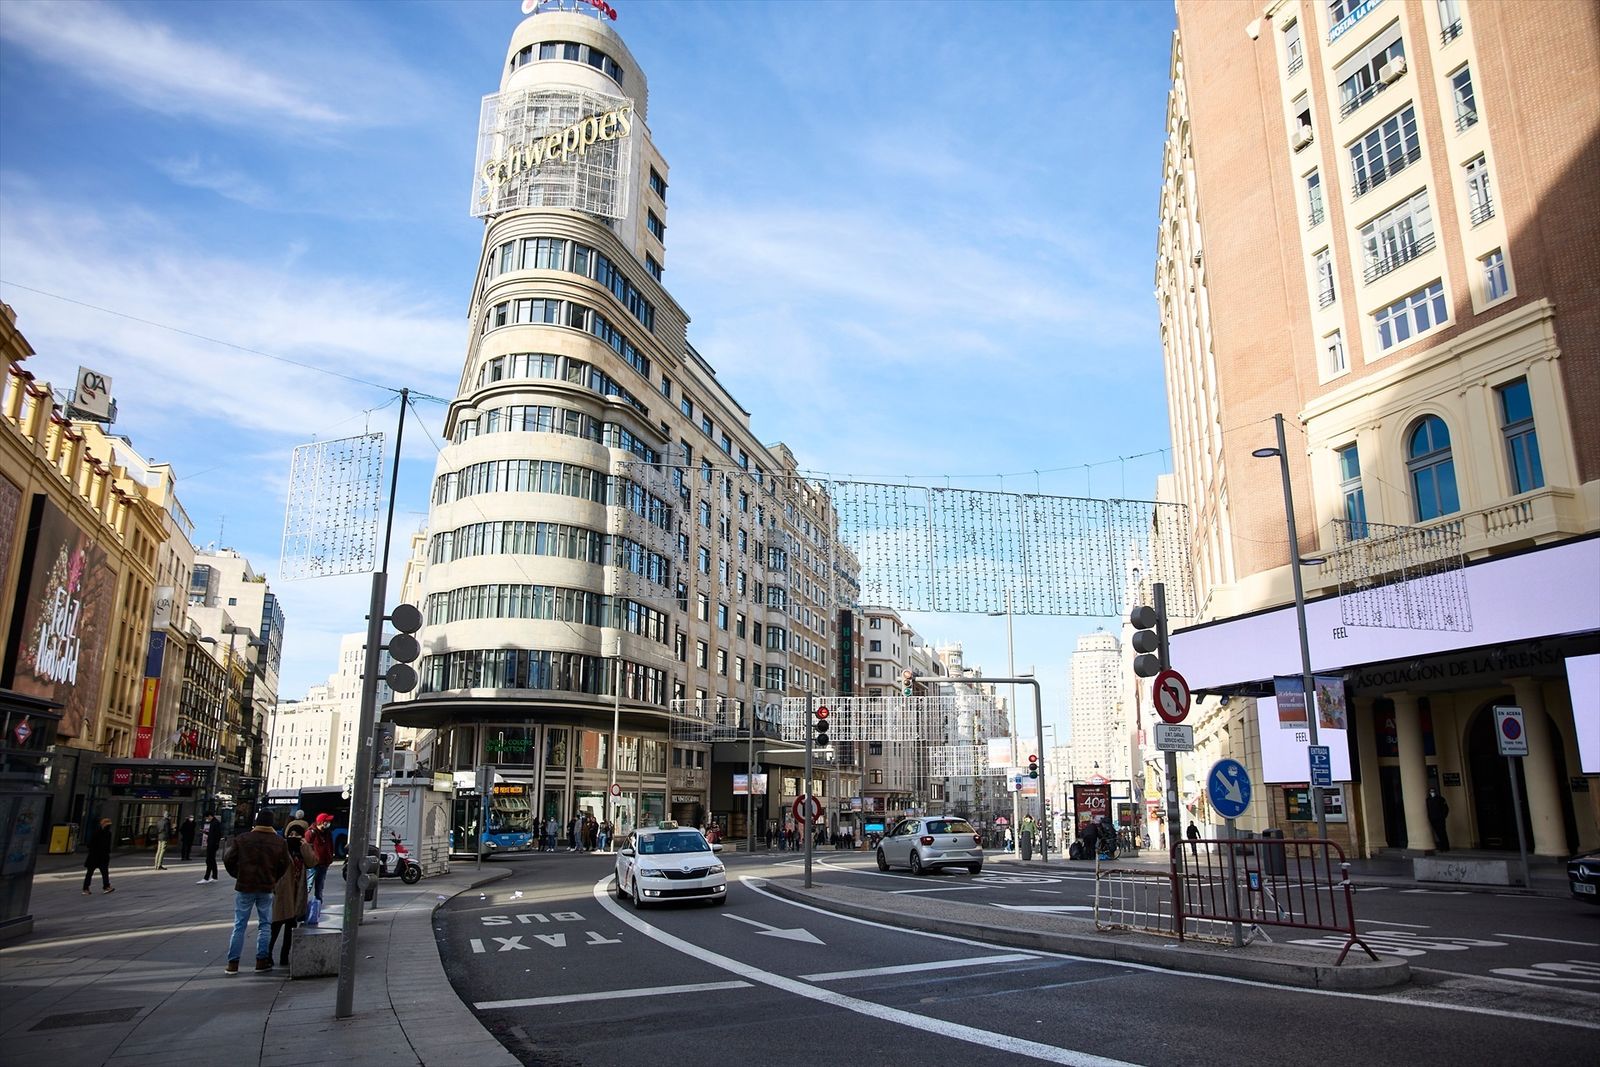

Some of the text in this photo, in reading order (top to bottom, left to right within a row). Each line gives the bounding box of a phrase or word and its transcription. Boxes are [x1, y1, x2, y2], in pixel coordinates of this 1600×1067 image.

[480, 105, 631, 204] Schweppes
[1333, 627, 1348, 640] FEEL
[842, 626, 851, 692] HOTEL
[1450, 660, 1470, 677] DE
[1474, 656, 1495, 673] LA
[1295, 732, 1308, 742] FEEL
[480, 911, 586, 926] BUS
